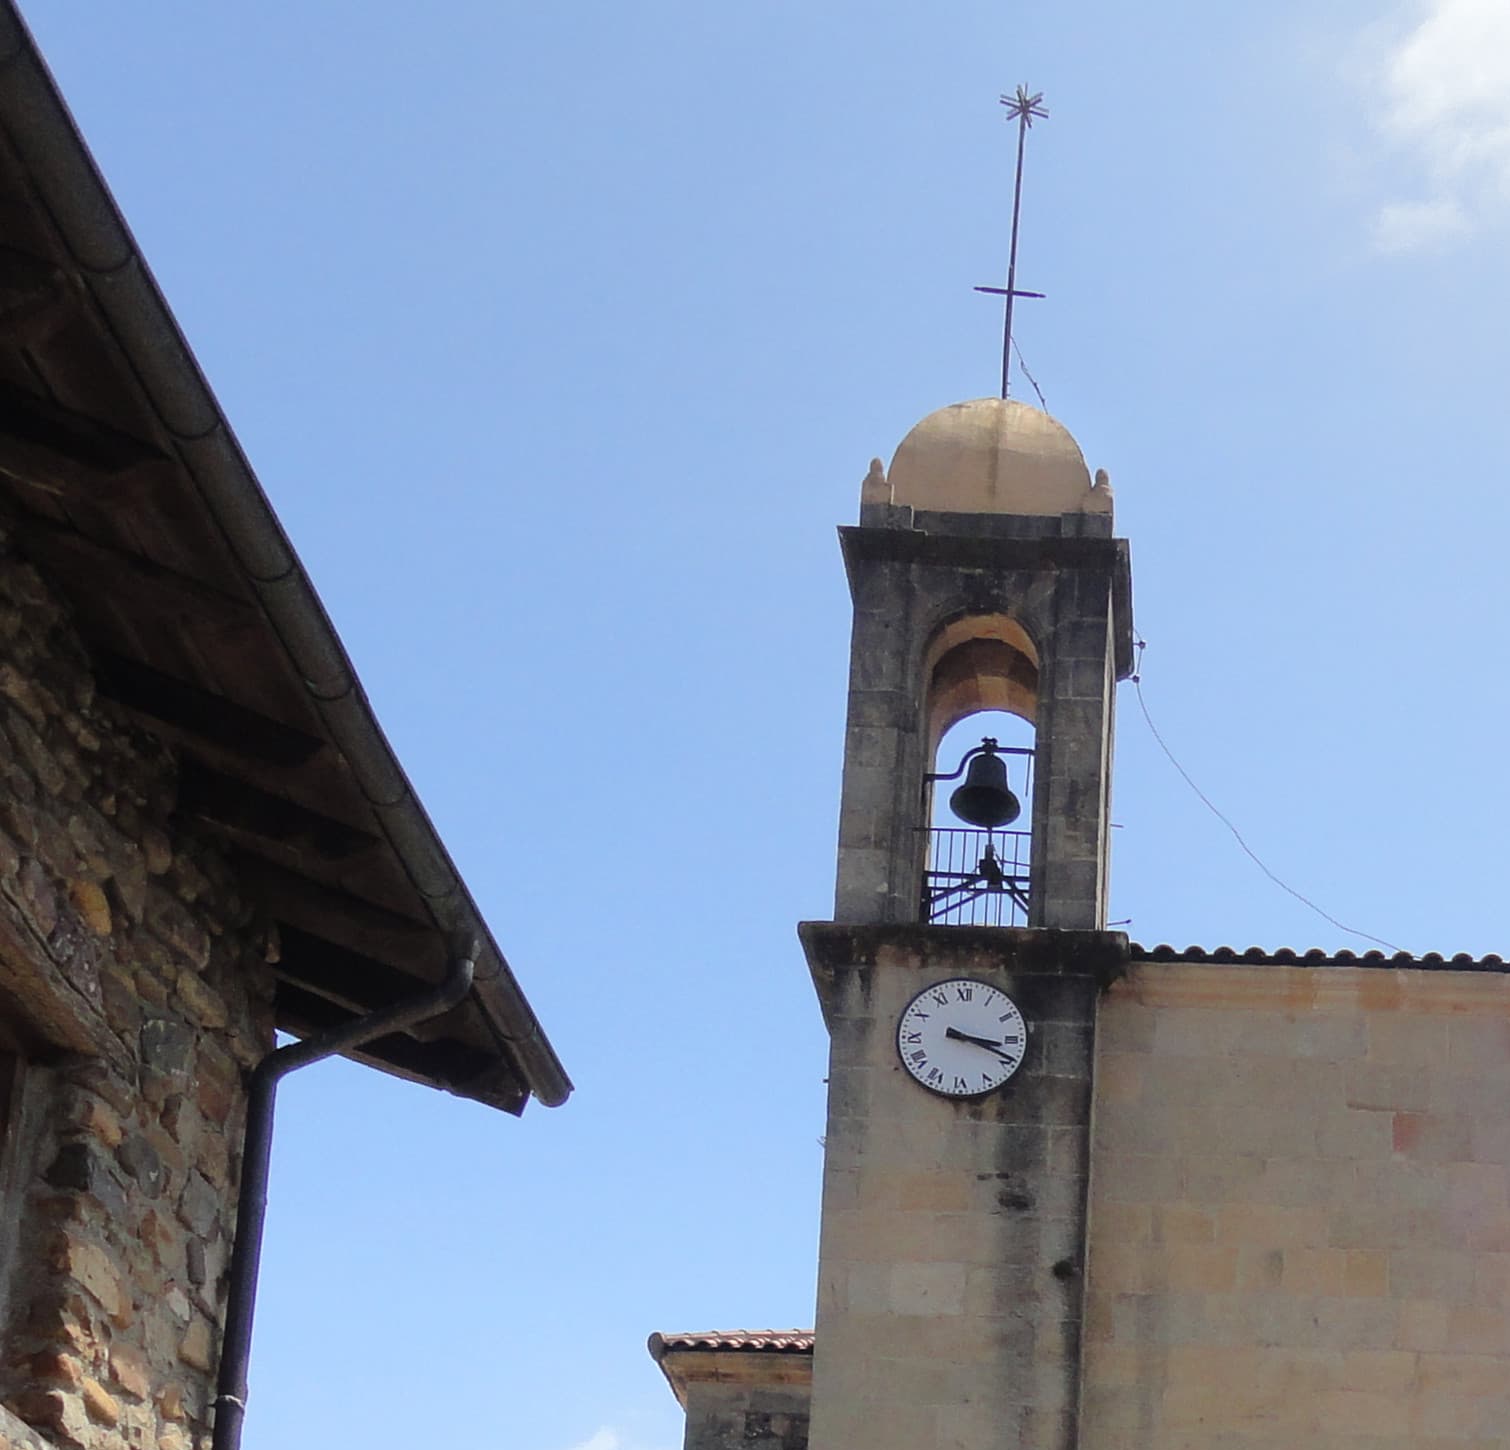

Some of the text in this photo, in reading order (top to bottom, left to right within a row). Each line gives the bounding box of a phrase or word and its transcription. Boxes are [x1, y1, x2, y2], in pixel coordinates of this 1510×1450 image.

[933, 992, 948, 1008] XI
[956, 988, 973, 1001] XII
[914, 1009, 930, 1022] X
[908, 1032, 922, 1044] IX
[954, 1076, 967, 1089] VI
[981, 1073, 993, 1085] V
